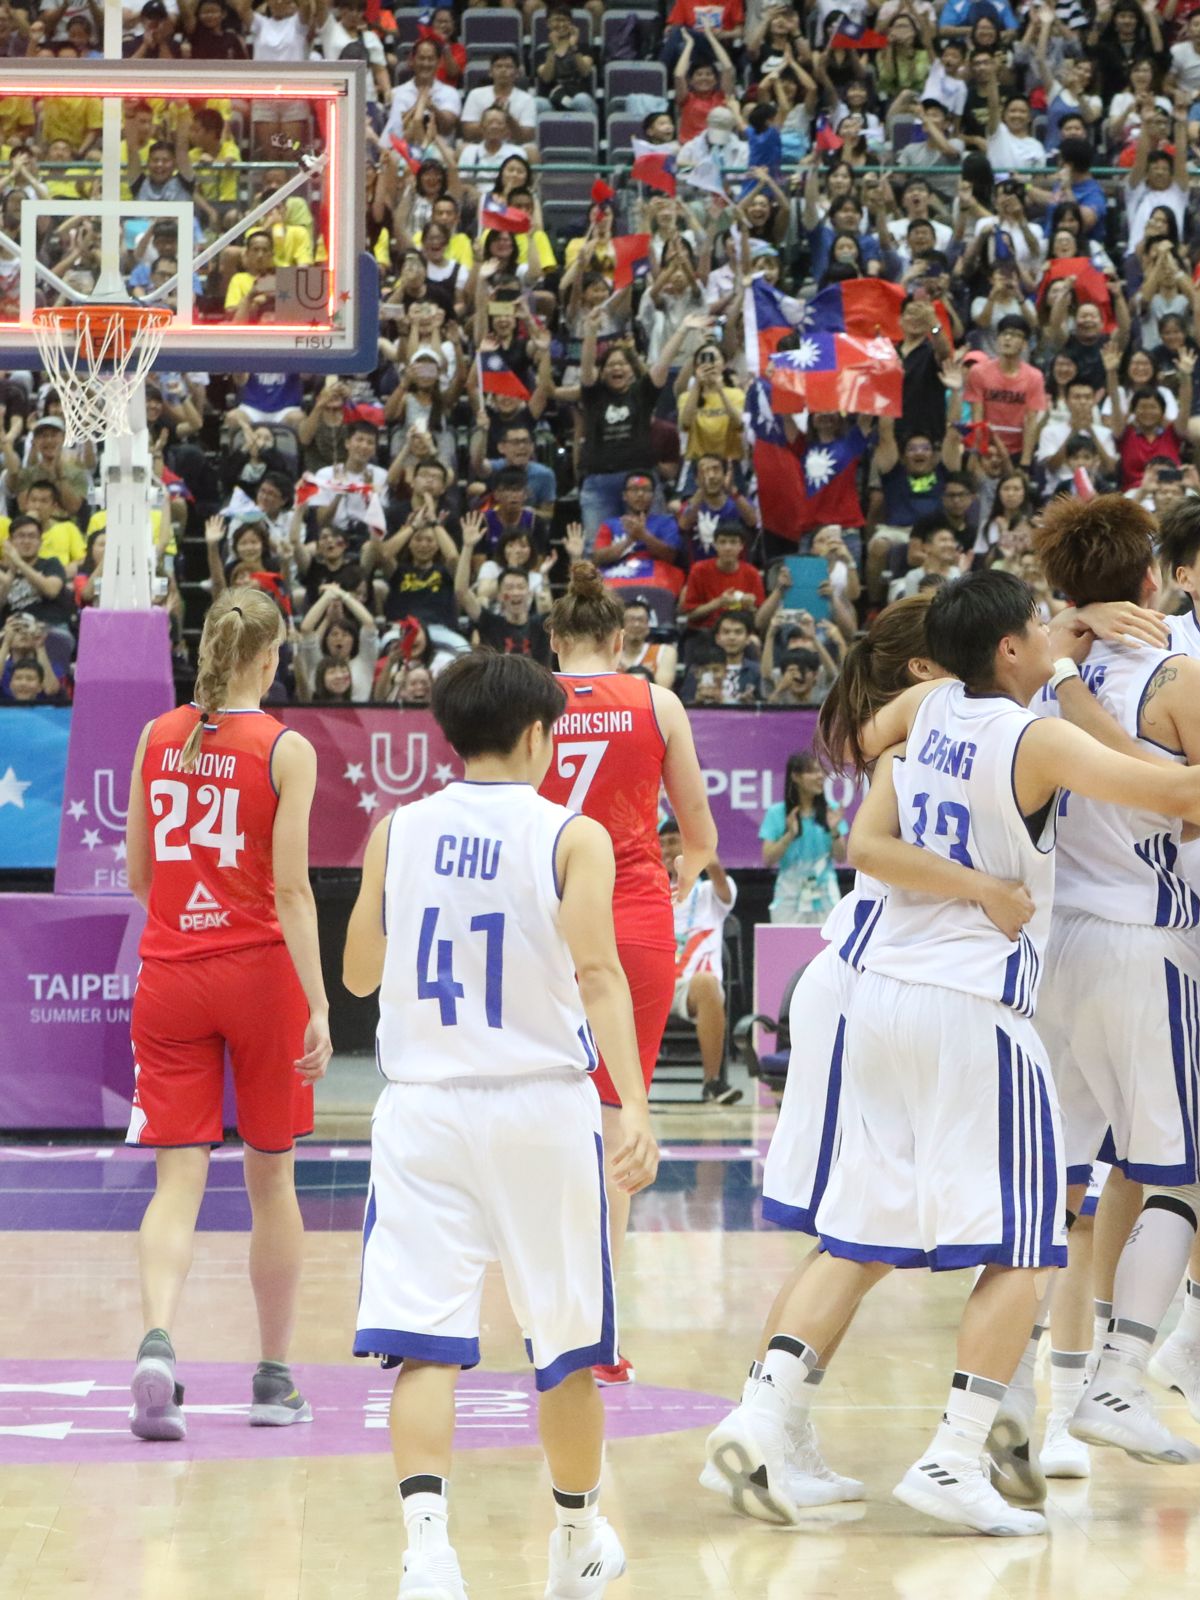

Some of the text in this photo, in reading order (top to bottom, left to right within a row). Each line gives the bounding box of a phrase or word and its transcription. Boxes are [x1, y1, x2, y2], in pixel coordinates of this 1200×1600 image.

[294, 335, 333, 349] FISU
[557, 740, 610, 814] 7
[150, 779, 245, 869] 24
[434, 834, 503, 881] CHU
[178, 910, 231, 933] PEAK
[27, 973, 130, 1000] TAIPEI
[416, 907, 505, 1030] 41
[30, 1008, 101, 1023] SUMMER
